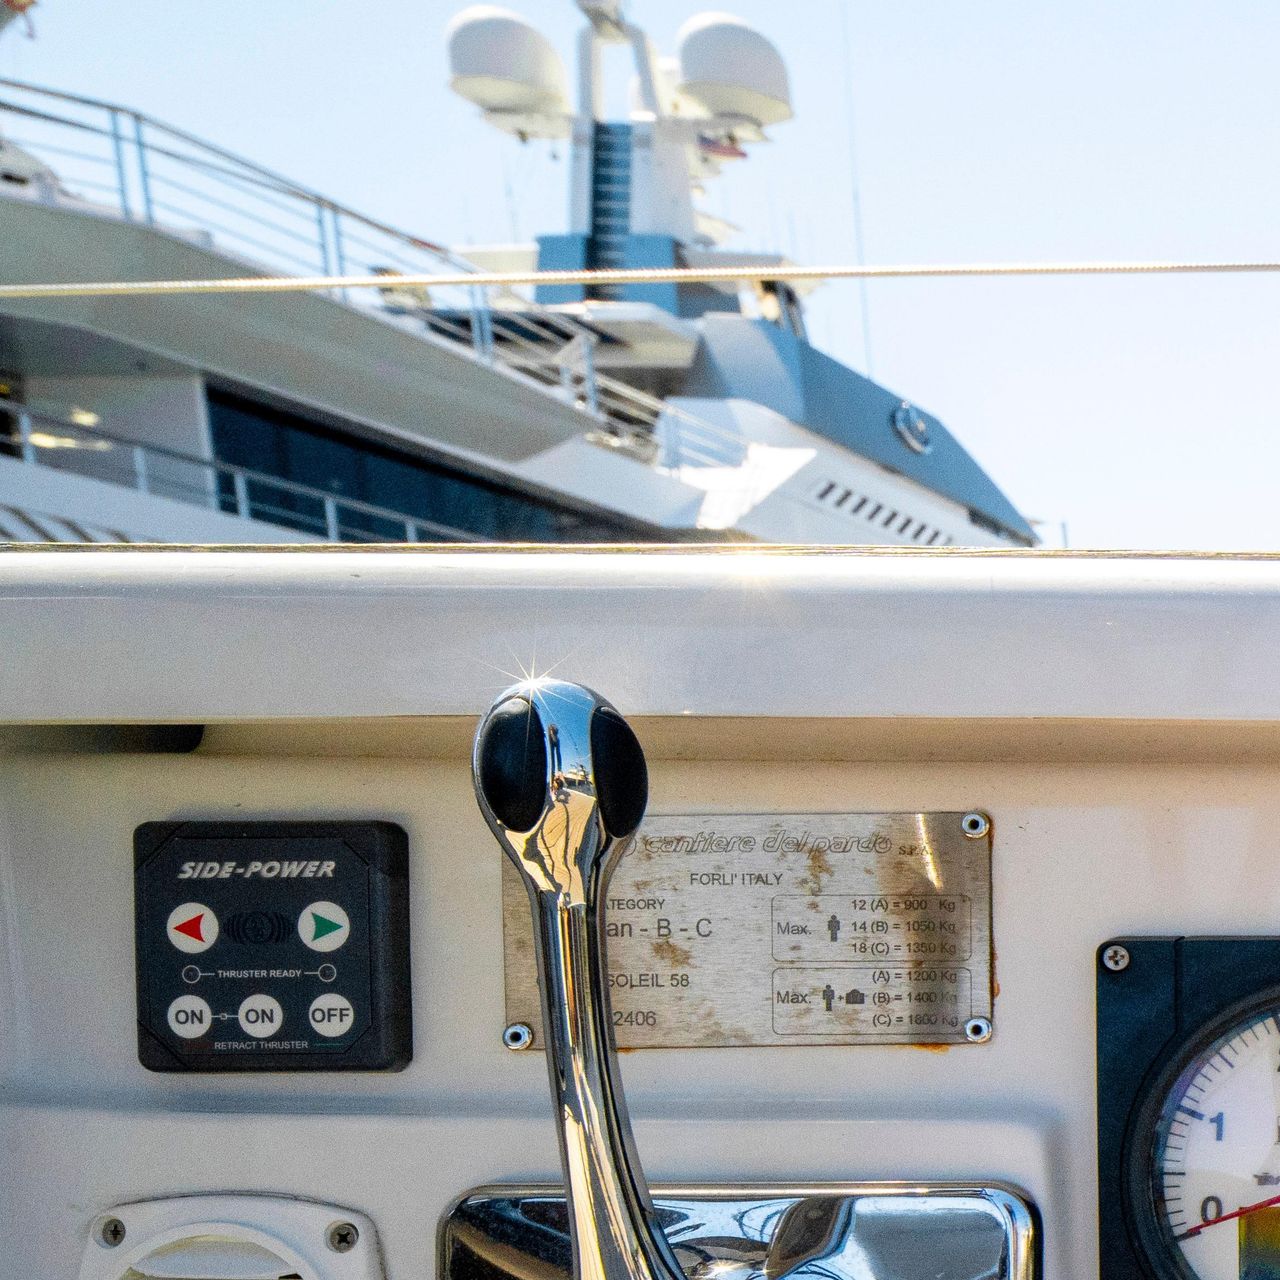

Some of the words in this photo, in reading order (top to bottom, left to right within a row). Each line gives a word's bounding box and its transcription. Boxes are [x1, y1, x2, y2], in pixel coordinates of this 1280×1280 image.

[763, 830, 811, 854] del
[808, 831, 892, 858] pardo
[177, 860, 336, 879] SIDE-POWER
[690, 873, 737, 886] FORLI'
[742, 873, 783, 886] ITALY
[605, 899, 665, 910] TEGORY
[852, 900, 866, 910] 12
[870, 899, 889, 912] (A)
[904, 899, 927, 910] 900
[939, 900, 956, 912] Kg
[606, 921, 633, 938] an
[657, 918, 672, 937] B
[696, 918, 713, 938] C
[777, 921, 812, 935] Max.
[852, 921, 867, 932] 14
[870, 921, 889, 933] (B)
[905, 921, 935, 932] 1050
[939, 921, 956, 934] Kg
[852, 943, 867, 953] 18
[870, 942, 890, 955] (C)
[906, 942, 936, 953] 1350
[940, 943, 957, 956] Kg
[218, 970, 268, 978] THRUSTER
[269, 969, 302, 978] READY
[607, 973, 665, 988] SOLEIL
[670, 973, 690, 988] 58
[872, 970, 890, 984] (A)
[907, 970, 937, 982] 1200
[940, 971, 957, 983] Kg
[776, 991, 812, 1004] Max.
[872, 992, 890, 1005] (B)
[174, 1009, 204, 1025] ON
[245, 1008, 274, 1024] ON
[311, 1007, 350, 1023] OFF
[613, 1010, 657, 1027] 2406
[872, 1014, 891, 1027] (C)
[214, 1041, 257, 1050] RETRACT
[259, 1041, 308, 1050] THRUSTER
[1209, 1112, 1224, 1141] 1
[1201, 1195, 1223, 1223] 0
